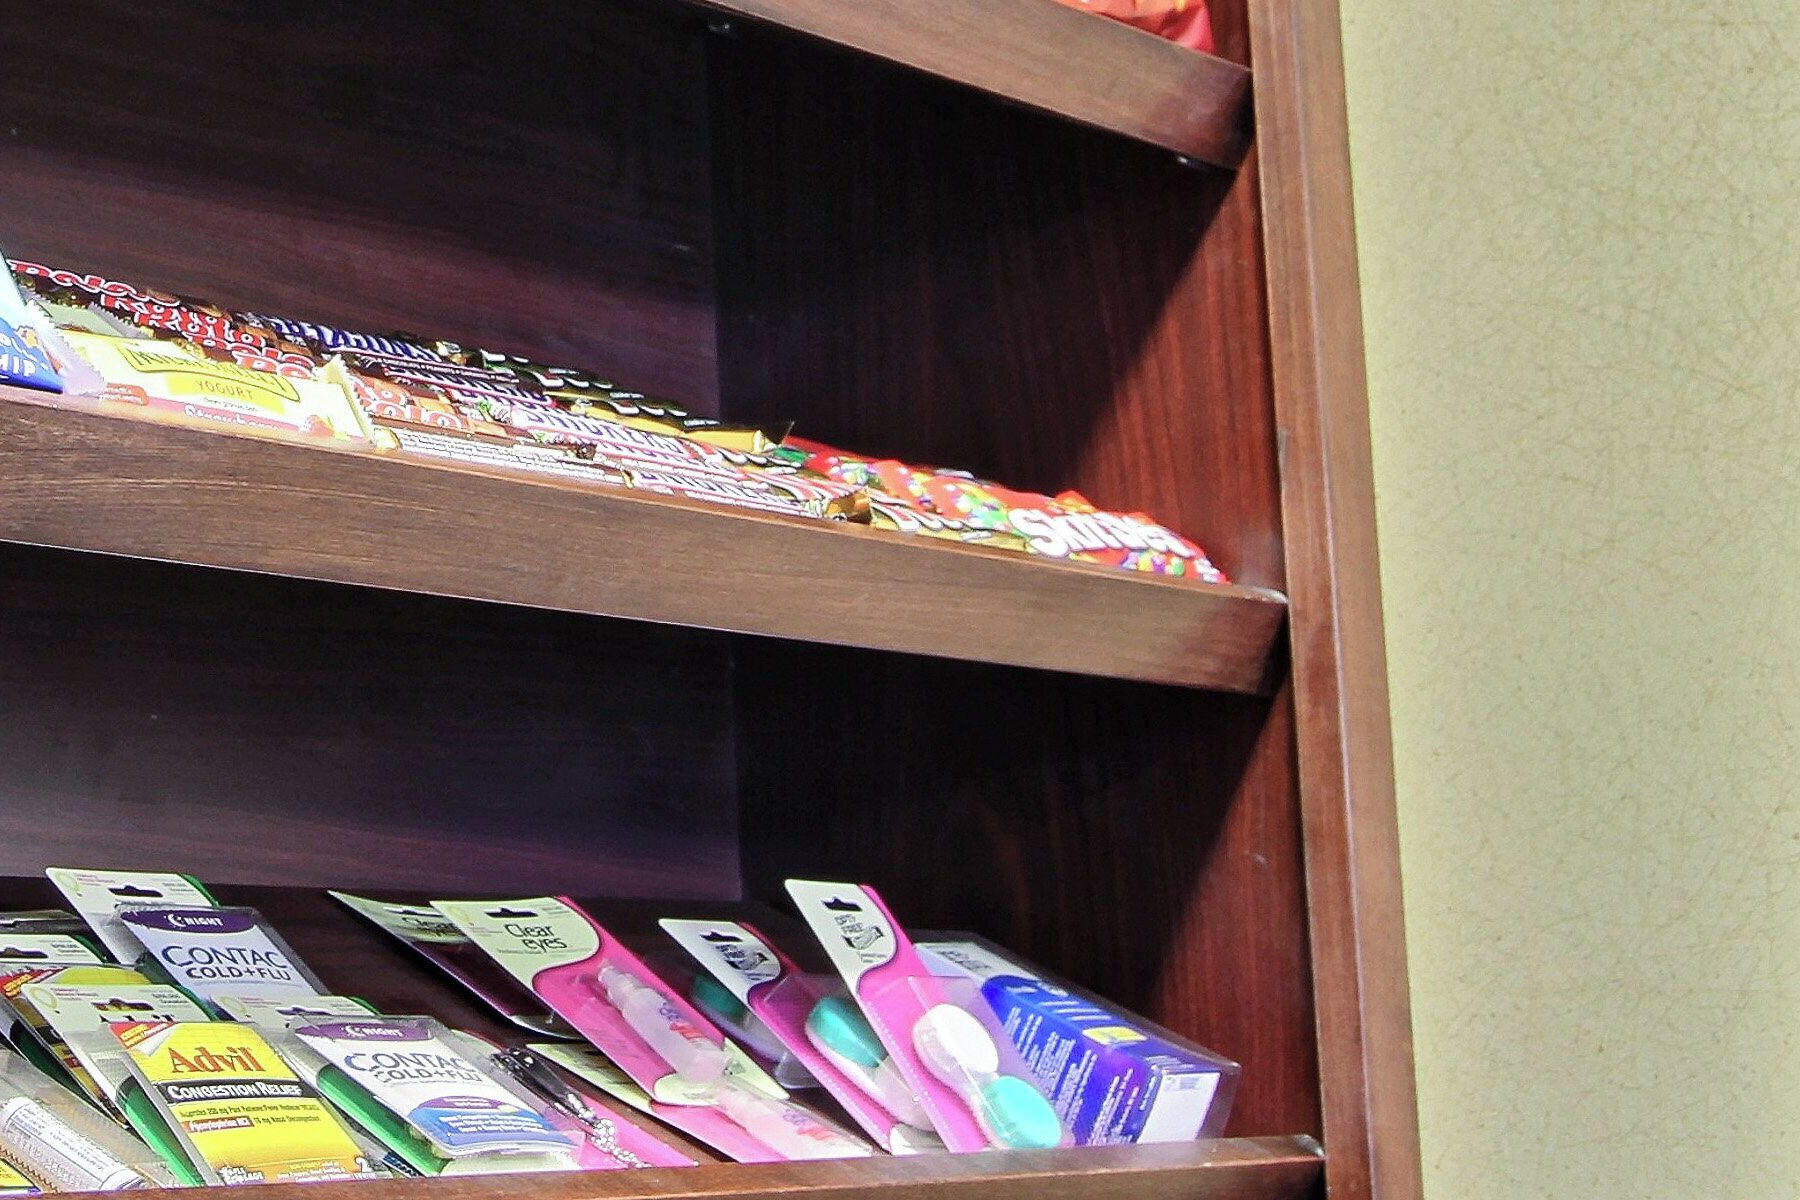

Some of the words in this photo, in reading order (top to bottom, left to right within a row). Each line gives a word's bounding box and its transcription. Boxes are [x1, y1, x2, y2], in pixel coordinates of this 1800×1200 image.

[197, 380, 253, 401] YOGURT
[183, 916, 224, 927] NIGHT
[505, 923, 554, 938] Clear
[521, 936, 568, 953] eyes
[161, 945, 288, 968] CONTAC
[185, 966, 292, 981] COLD+FLU
[167, 1045, 266, 1074] Advil
[343, 1052, 476, 1072] CONTAC
[166, 1083, 259, 1100] CONGESTION
[258, 1081, 302, 1096] RELIEF
